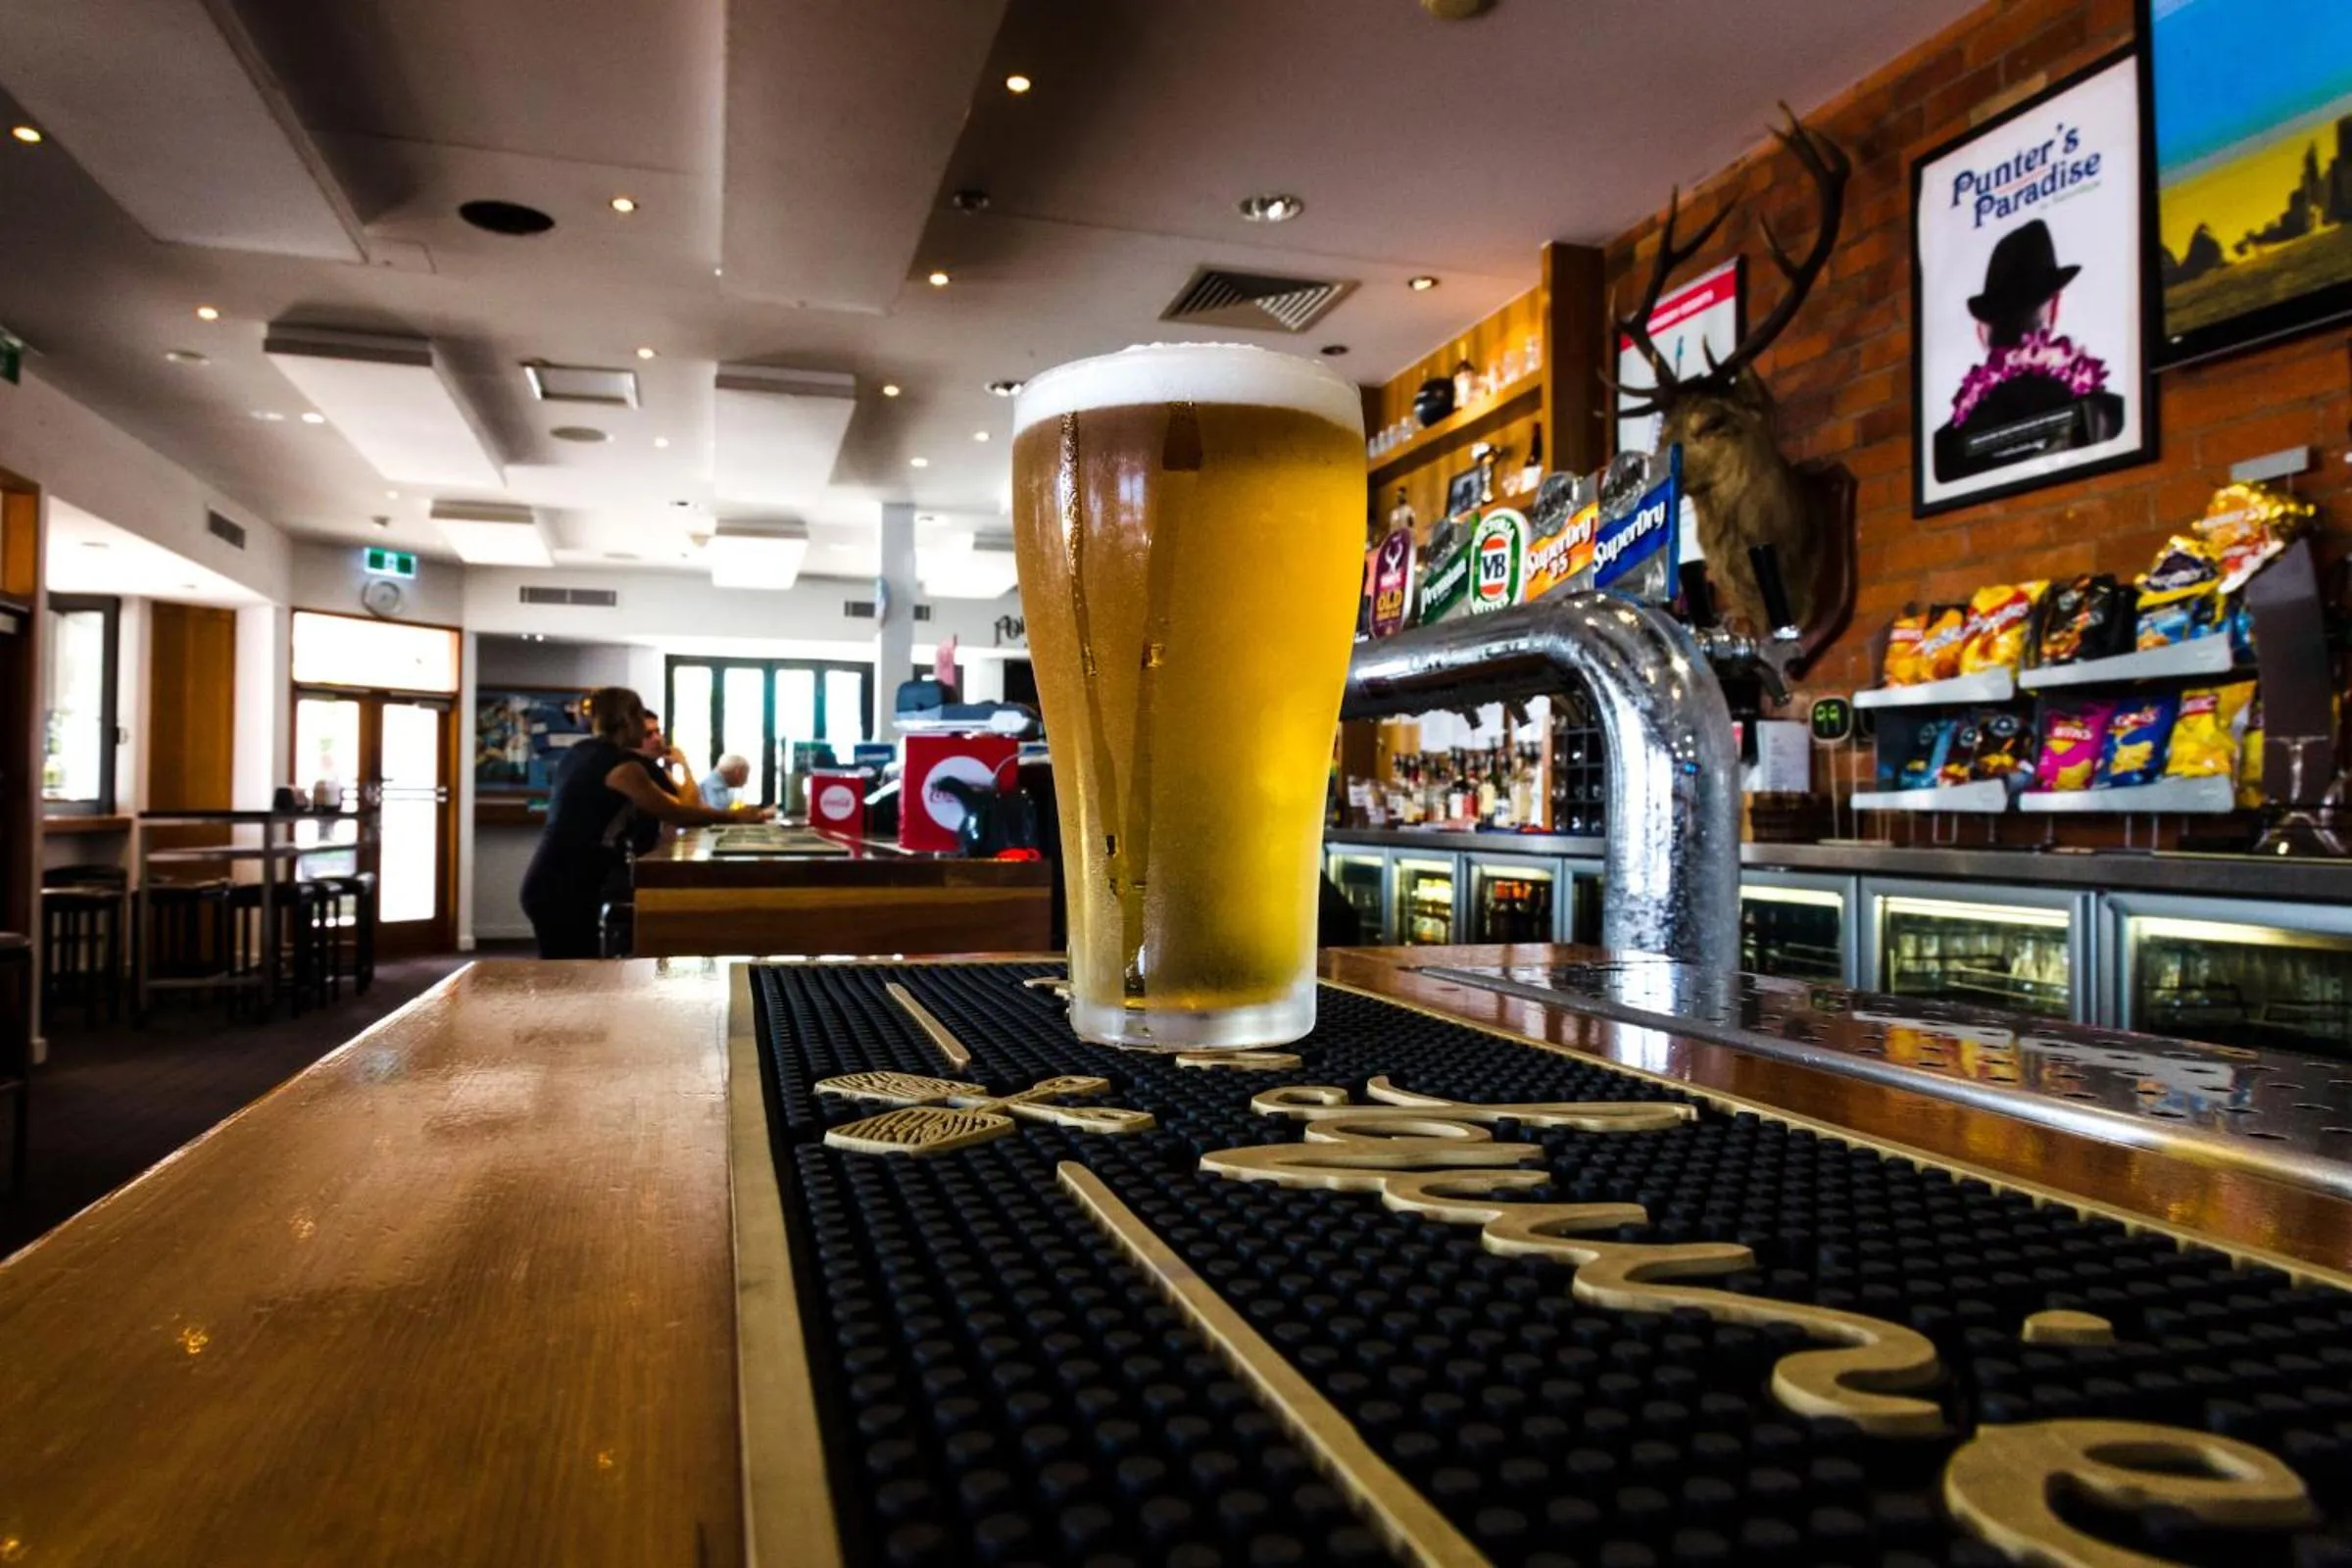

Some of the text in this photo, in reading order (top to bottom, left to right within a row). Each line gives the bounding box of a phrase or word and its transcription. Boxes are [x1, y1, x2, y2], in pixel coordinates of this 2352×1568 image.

[1949, 122, 2080, 209] Punter's
[1974, 152, 2102, 228] Paradise
[1482, 553, 1506, 581] VB
[1592, 501, 1666, 574] SuperDry
[1376, 588, 1403, 612] OLD
